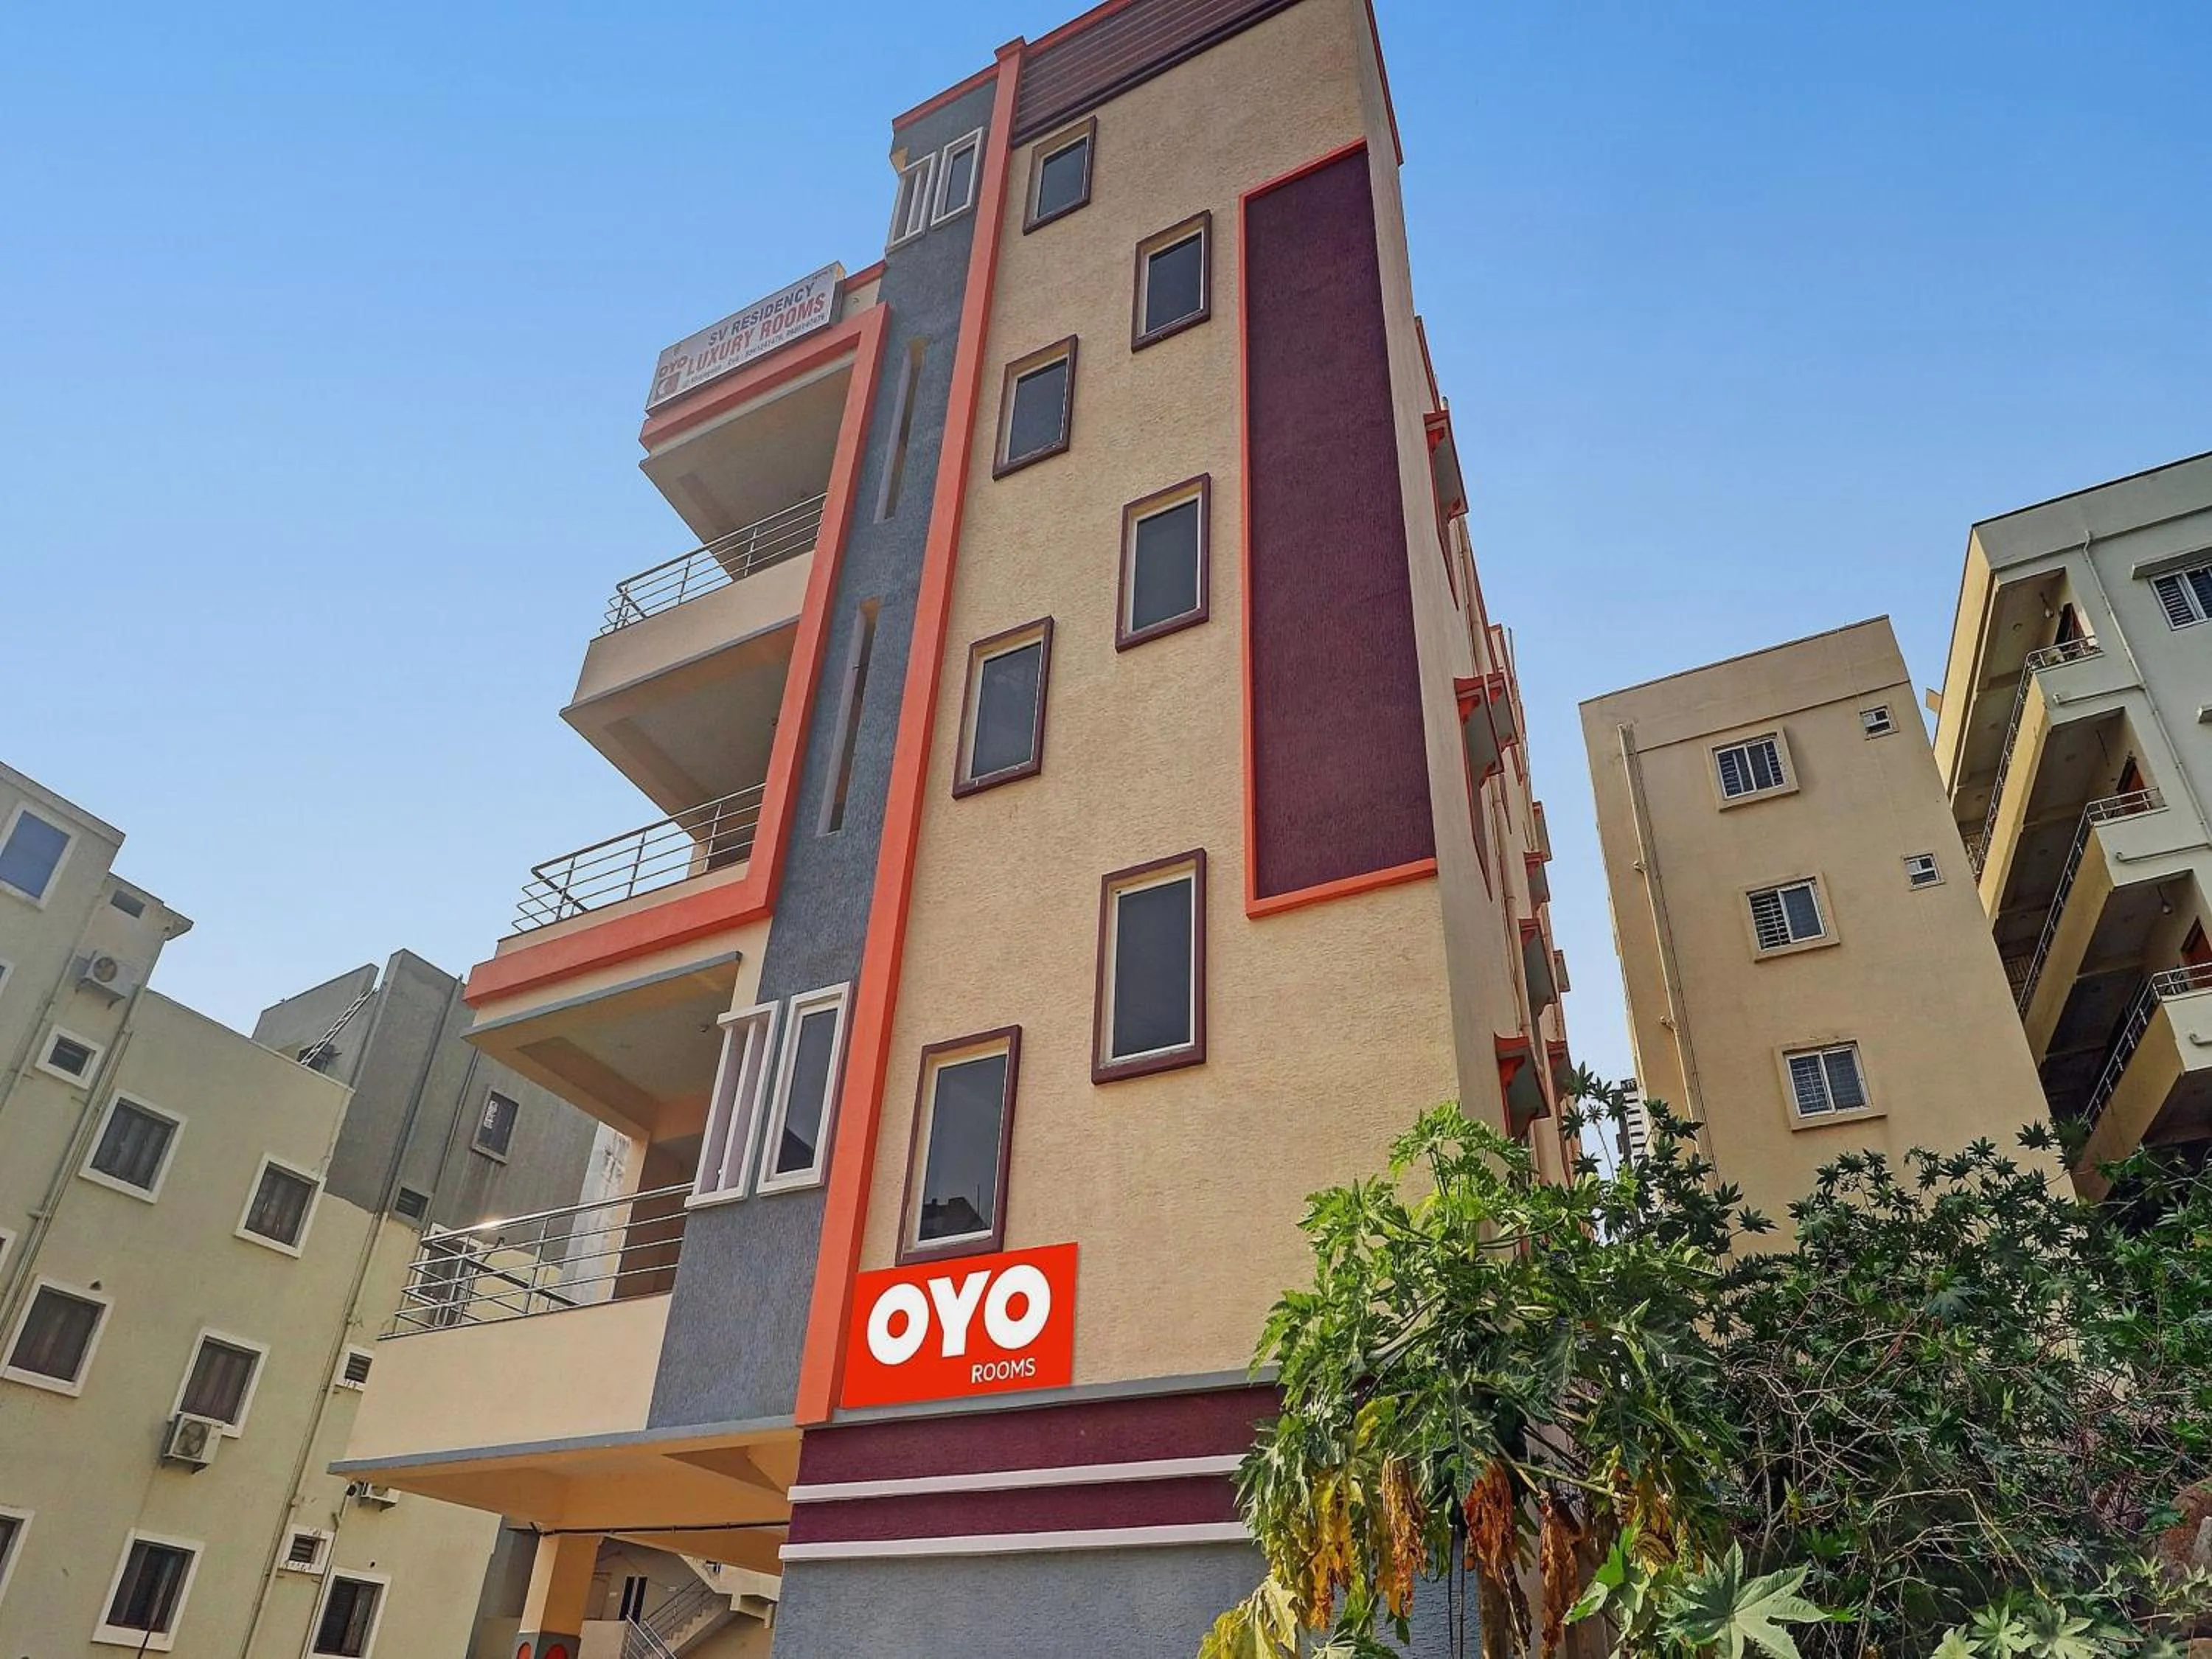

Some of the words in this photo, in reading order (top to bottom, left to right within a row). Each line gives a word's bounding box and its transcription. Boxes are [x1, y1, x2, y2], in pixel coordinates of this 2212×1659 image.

[687, 327, 754, 375] LUXURY
[759, 292, 825, 340] ROOMS
[709, 327, 728, 346] SV
[731, 282, 815, 335] RESIDENCY
[867, 1265, 1051, 1365] OYO
[970, 1357, 1036, 1383] ROOMS
